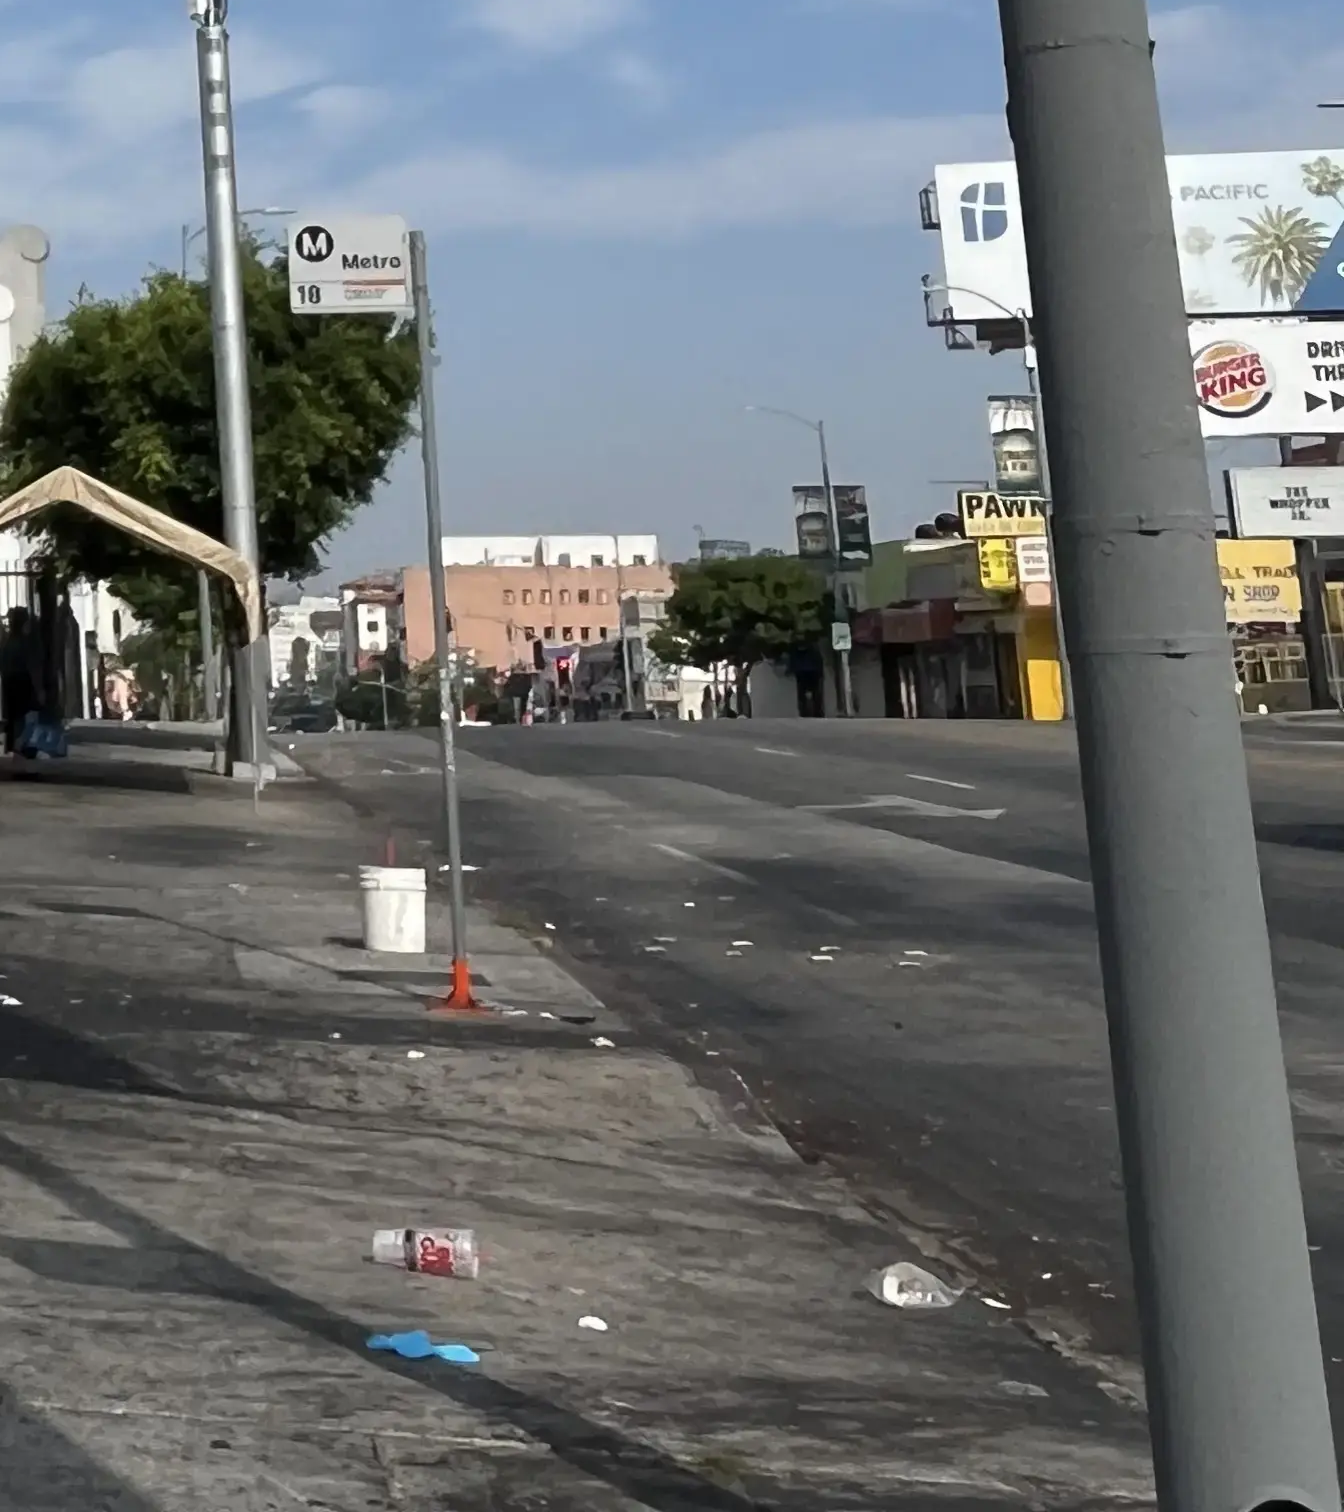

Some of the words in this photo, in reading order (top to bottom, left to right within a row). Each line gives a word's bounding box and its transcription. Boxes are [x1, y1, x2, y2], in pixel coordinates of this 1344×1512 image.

[1180, 184, 1269, 201] PACIFIC
[342, 254, 401, 270] Metro
[1195, 353, 1262, 383] BURGER
[1200, 367, 1266, 402] KING
